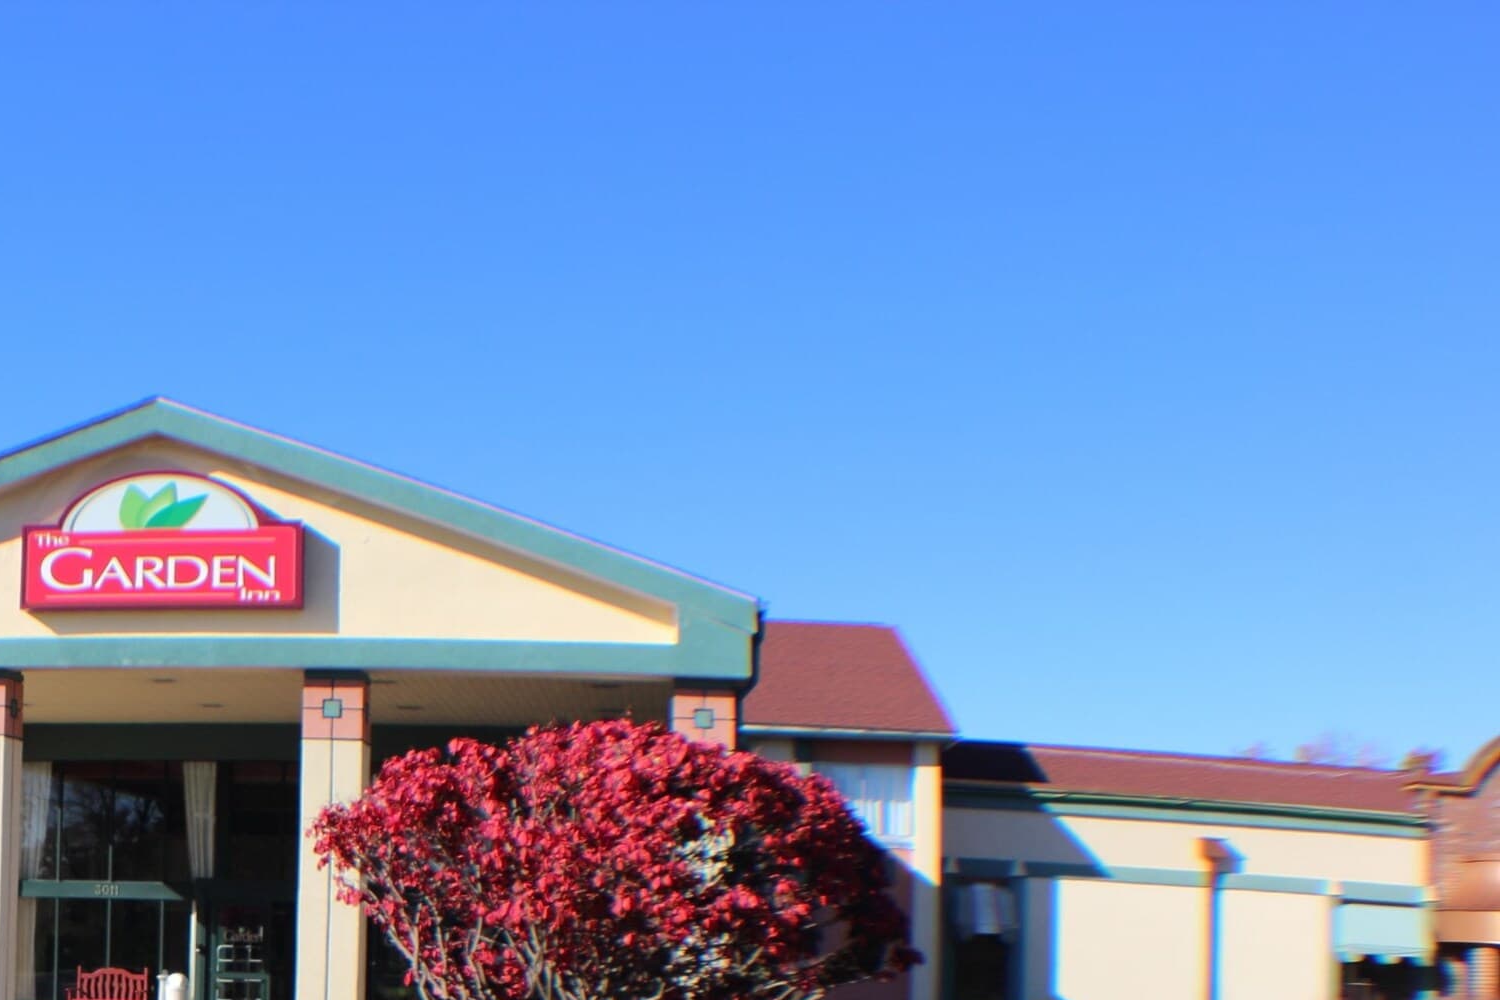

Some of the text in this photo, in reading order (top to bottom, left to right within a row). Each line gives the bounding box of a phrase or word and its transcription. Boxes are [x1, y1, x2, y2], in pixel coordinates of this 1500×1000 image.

[35, 532, 69, 548] The
[40, 547, 276, 590] GARDEN
[239, 586, 281, 601] Inn
